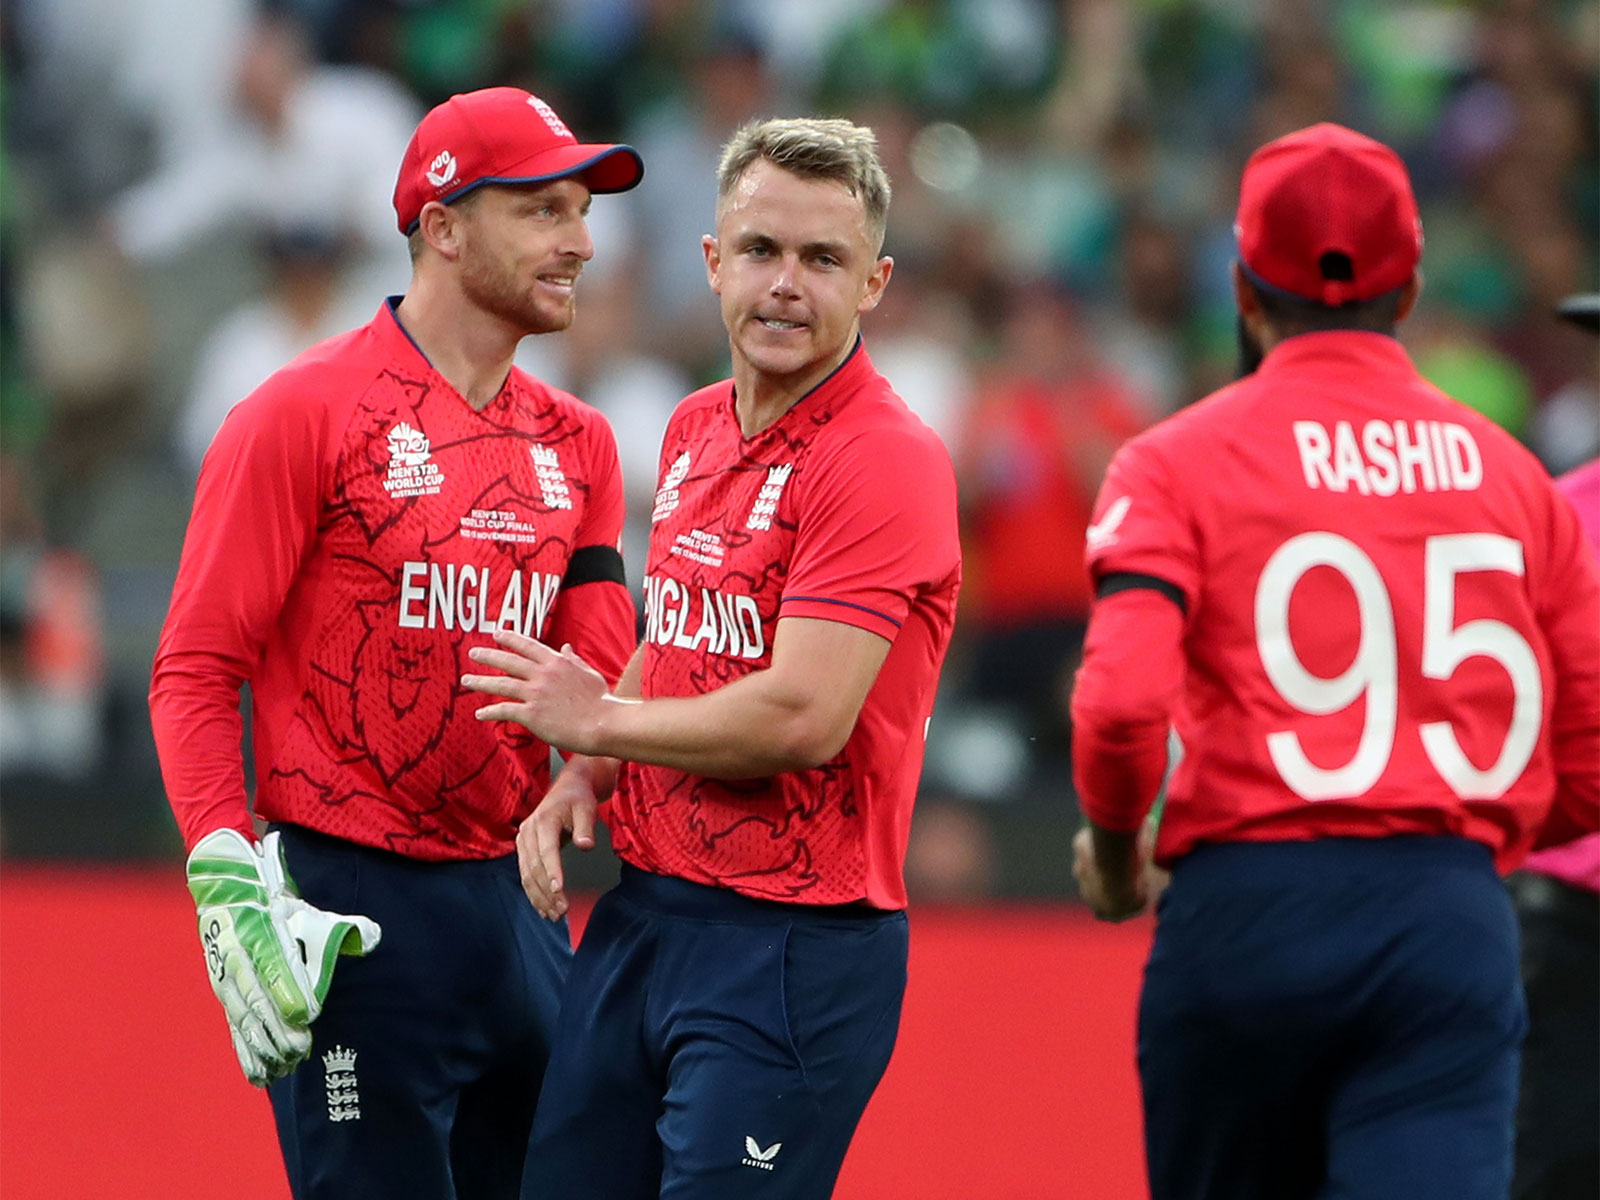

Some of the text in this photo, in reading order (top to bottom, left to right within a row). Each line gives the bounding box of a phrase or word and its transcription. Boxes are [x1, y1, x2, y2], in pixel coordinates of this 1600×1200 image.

[1293, 419, 1483, 496] RASHID
[388, 463, 438, 479] MEN'S T20
[382, 474, 445, 491] WORLD CUP
[498, 511, 516, 521] T20
[460, 517, 536, 533] WORLD CUP FINAL
[643, 575, 765, 659] NGLAND
[1254, 531, 1543, 802] 95
